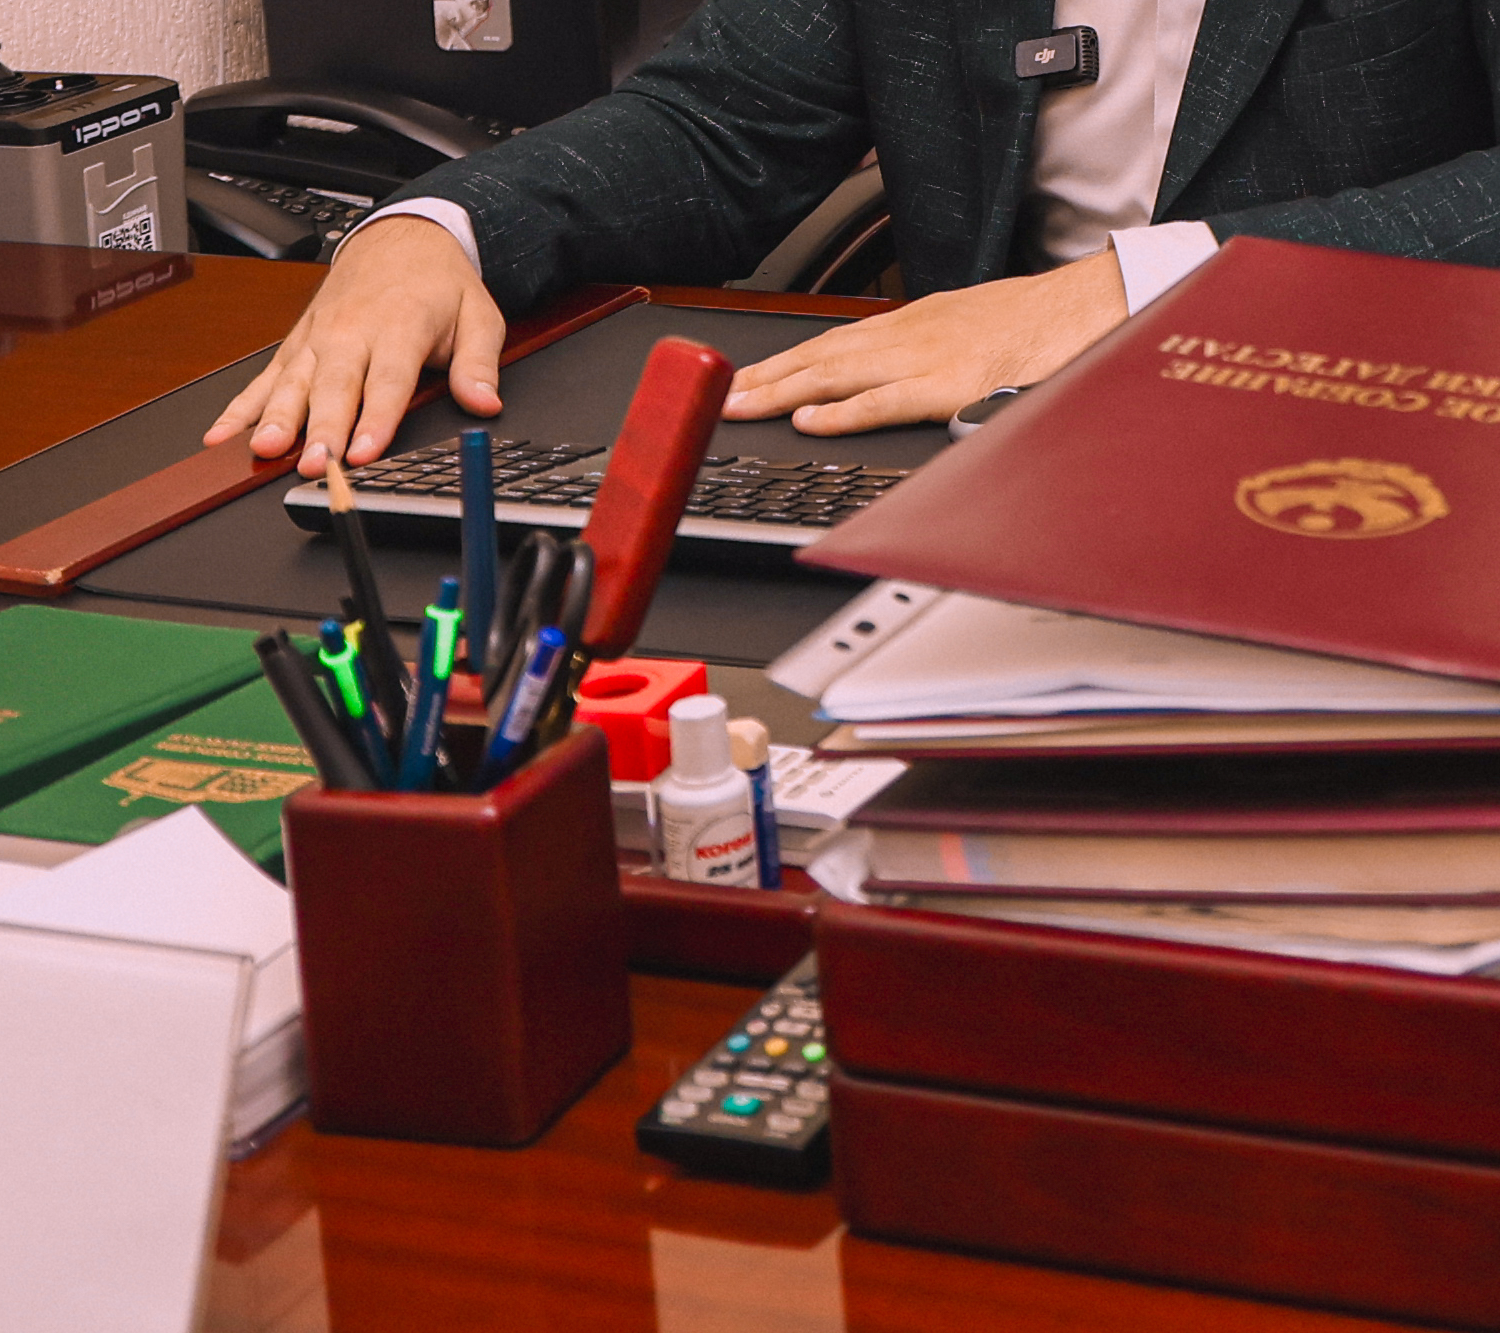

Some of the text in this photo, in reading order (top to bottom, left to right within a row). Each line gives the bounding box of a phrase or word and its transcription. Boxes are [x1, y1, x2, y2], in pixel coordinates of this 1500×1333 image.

[1034, 48, 1056, 64] dji
[72, 102, 162, 144] ippon
[1158, 333, 1433, 393] ДАГЕСТАН
[1160, 358, 1441, 417] СОБРАНИЕ
